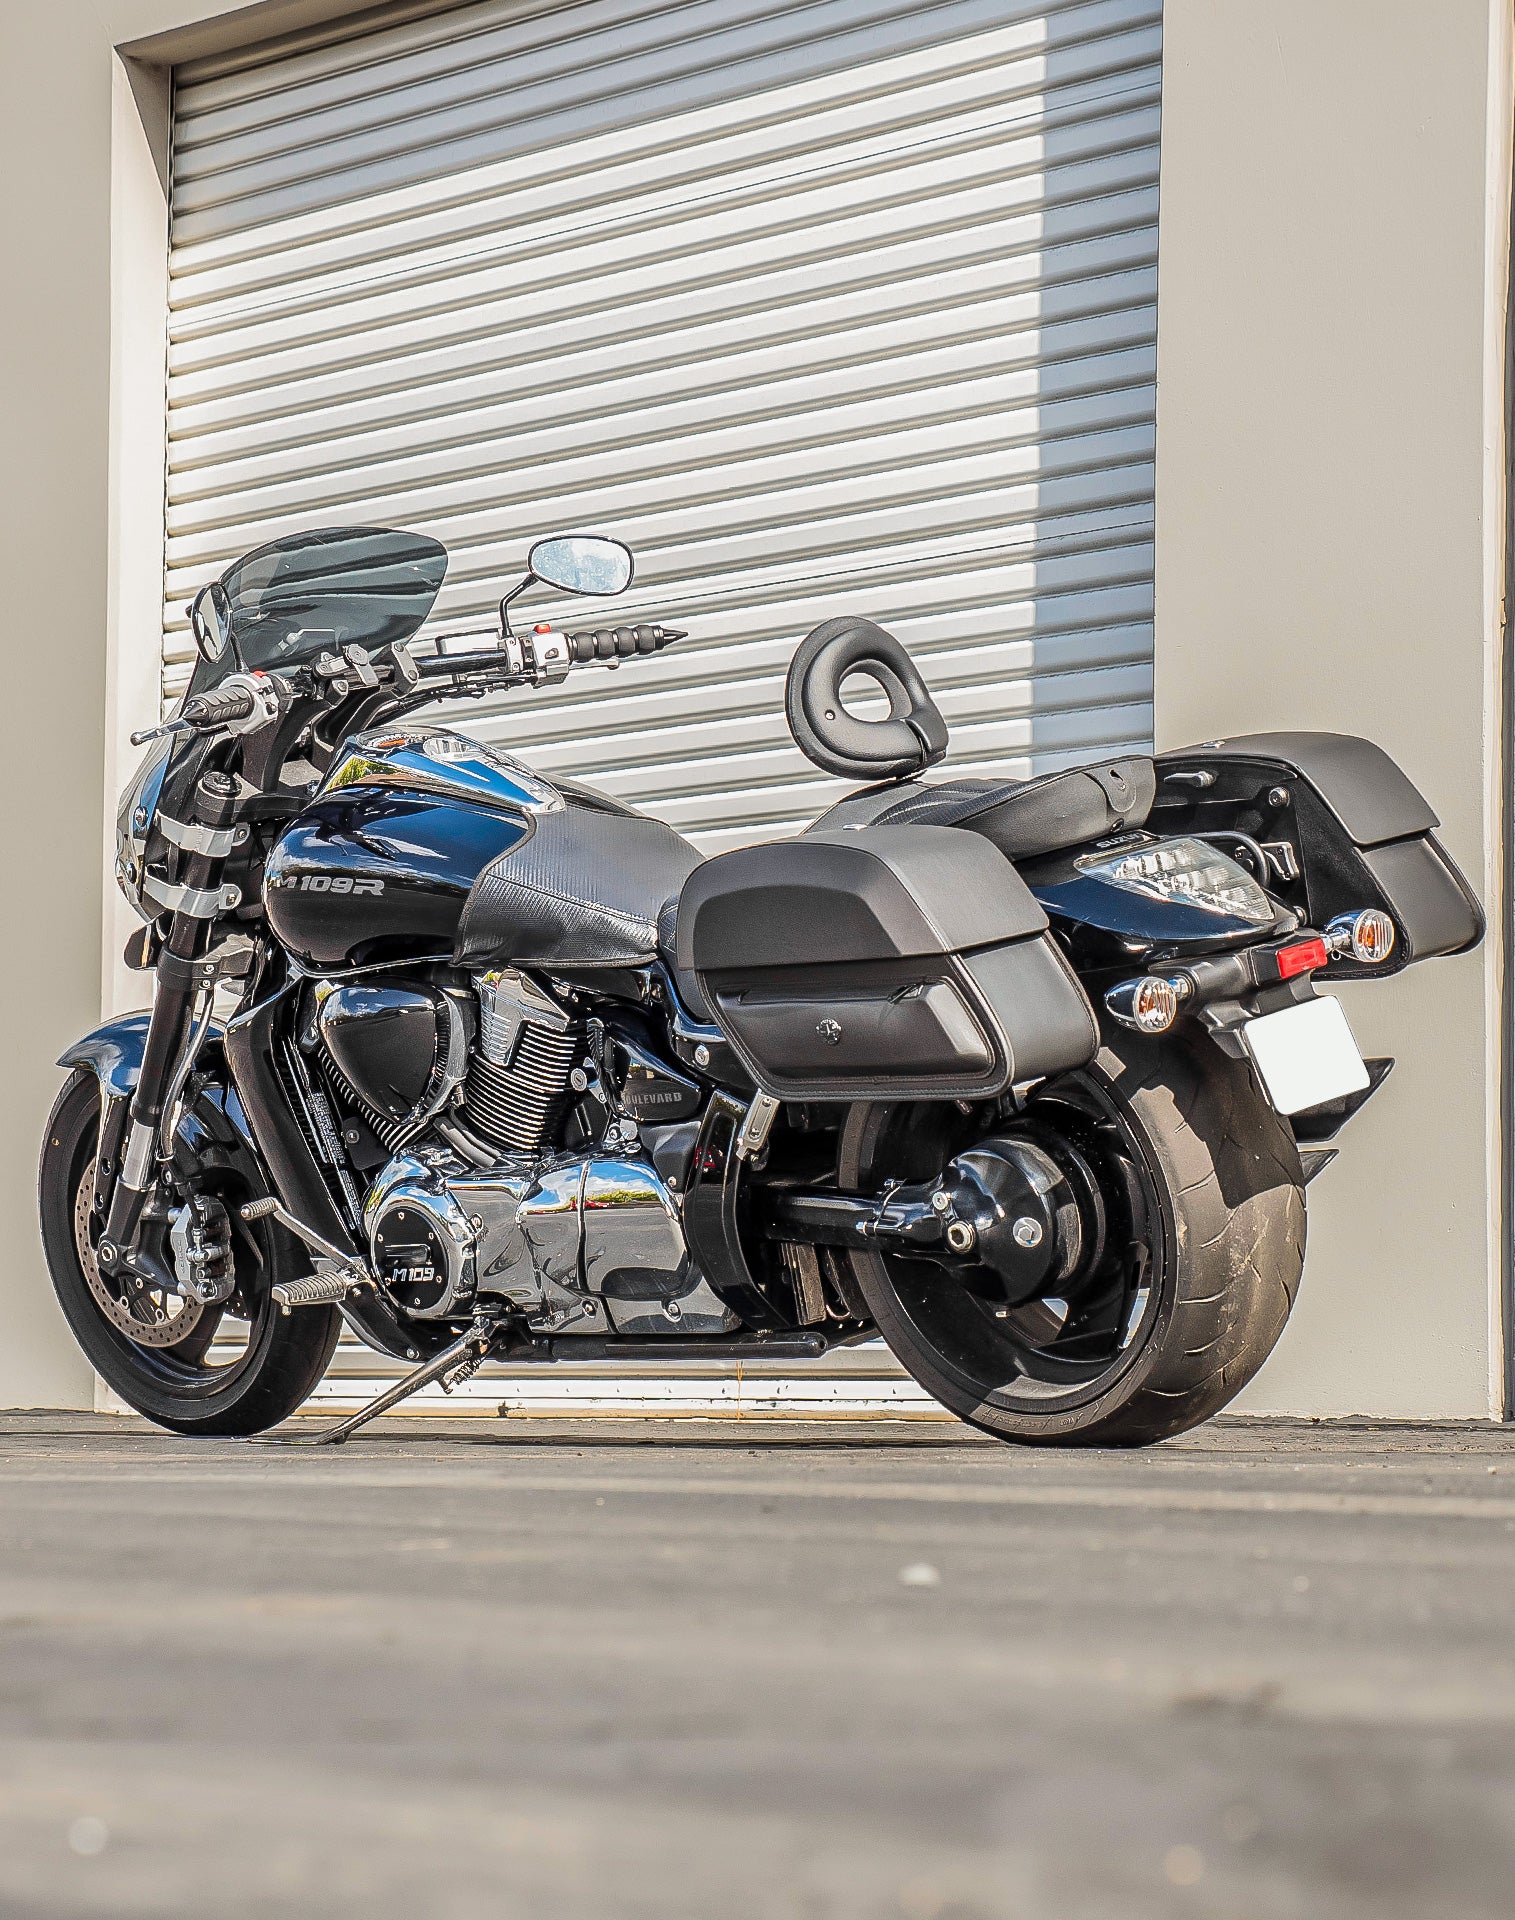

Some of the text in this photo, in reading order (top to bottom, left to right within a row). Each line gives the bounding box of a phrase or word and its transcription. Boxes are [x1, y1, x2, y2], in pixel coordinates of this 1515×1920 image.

[274, 875, 385, 896] M109R
[624, 1092, 682, 1105] OULEVARD
[392, 1267, 435, 1282] M109
